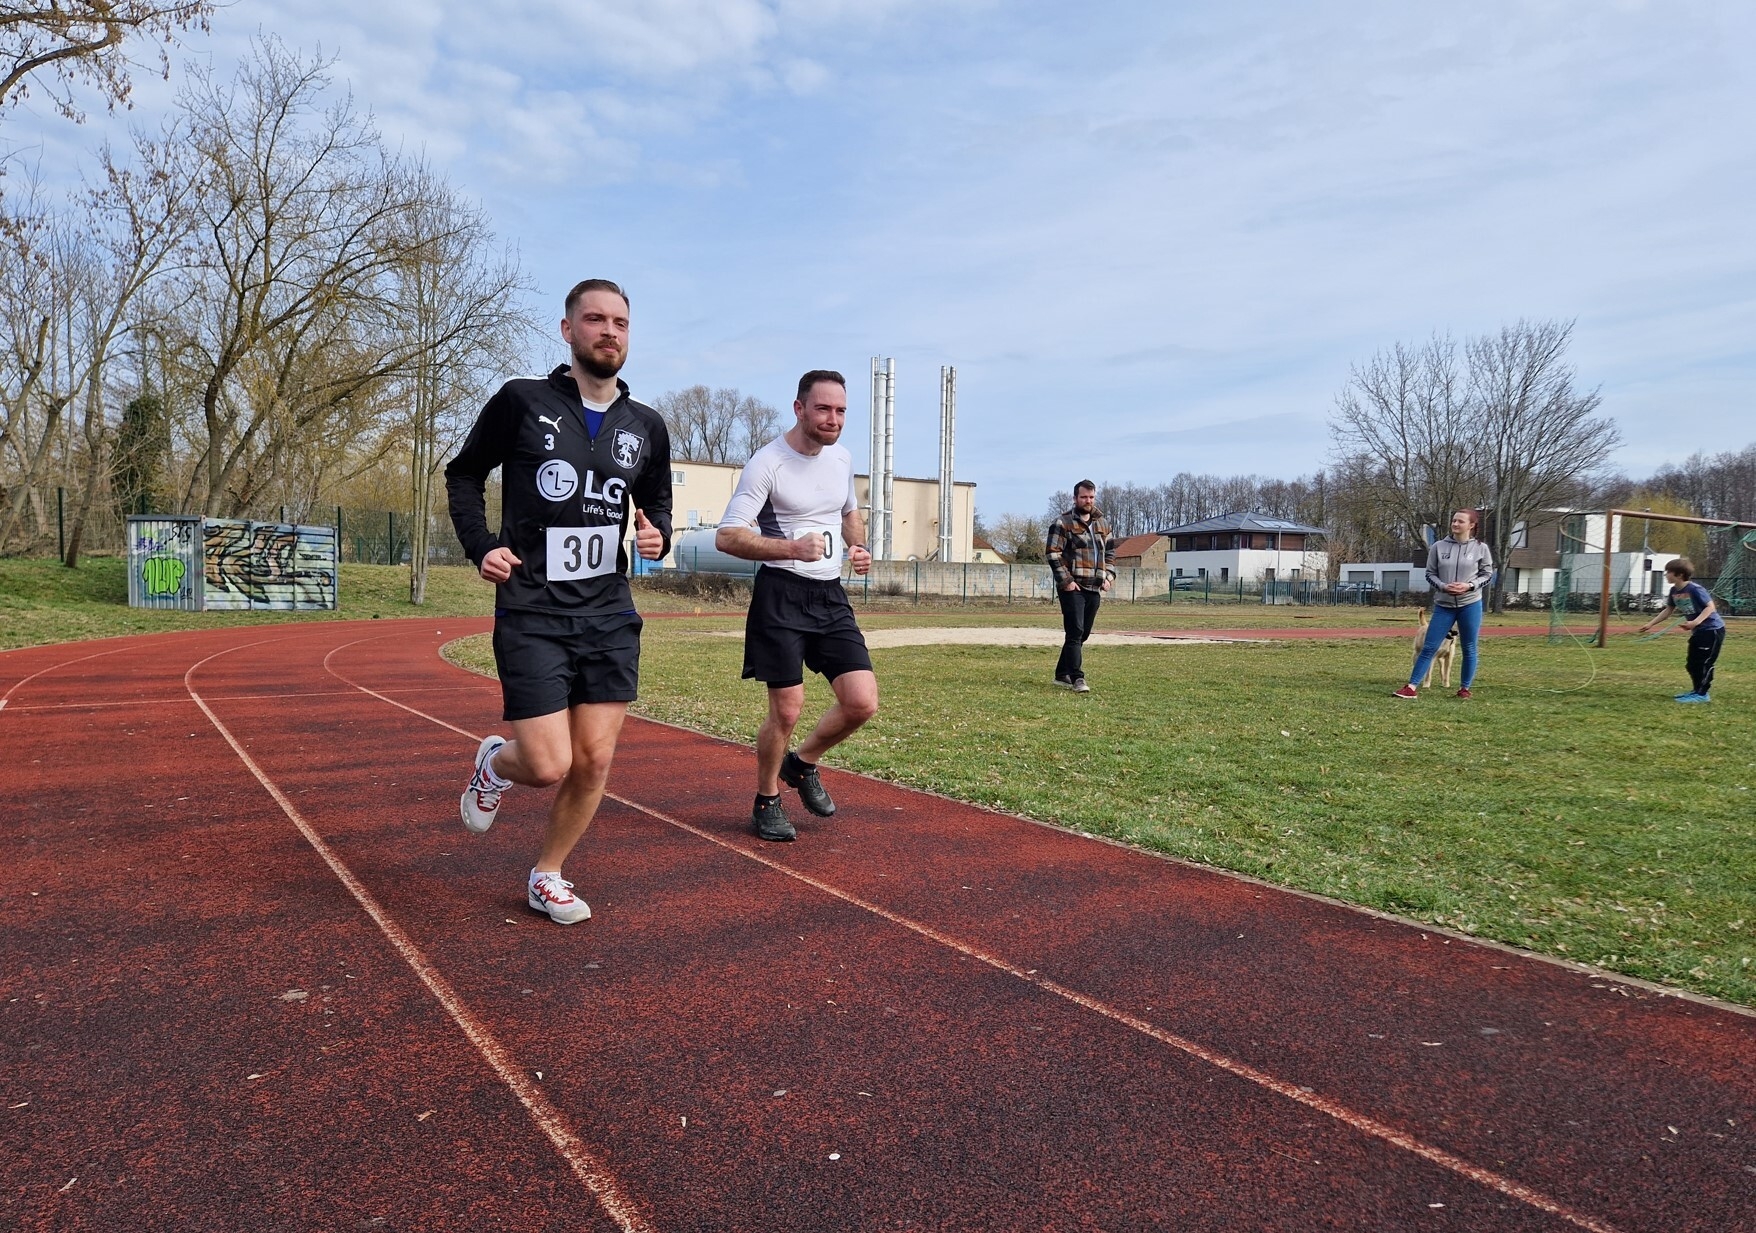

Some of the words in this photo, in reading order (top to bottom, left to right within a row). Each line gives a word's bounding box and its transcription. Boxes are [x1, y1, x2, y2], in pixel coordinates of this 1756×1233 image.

[544, 433, 555, 451] 3
[584, 470, 627, 504] LG
[582, 503, 605, 516] Life's
[606, 508, 624, 520] Good
[563, 533, 605, 573] 30
